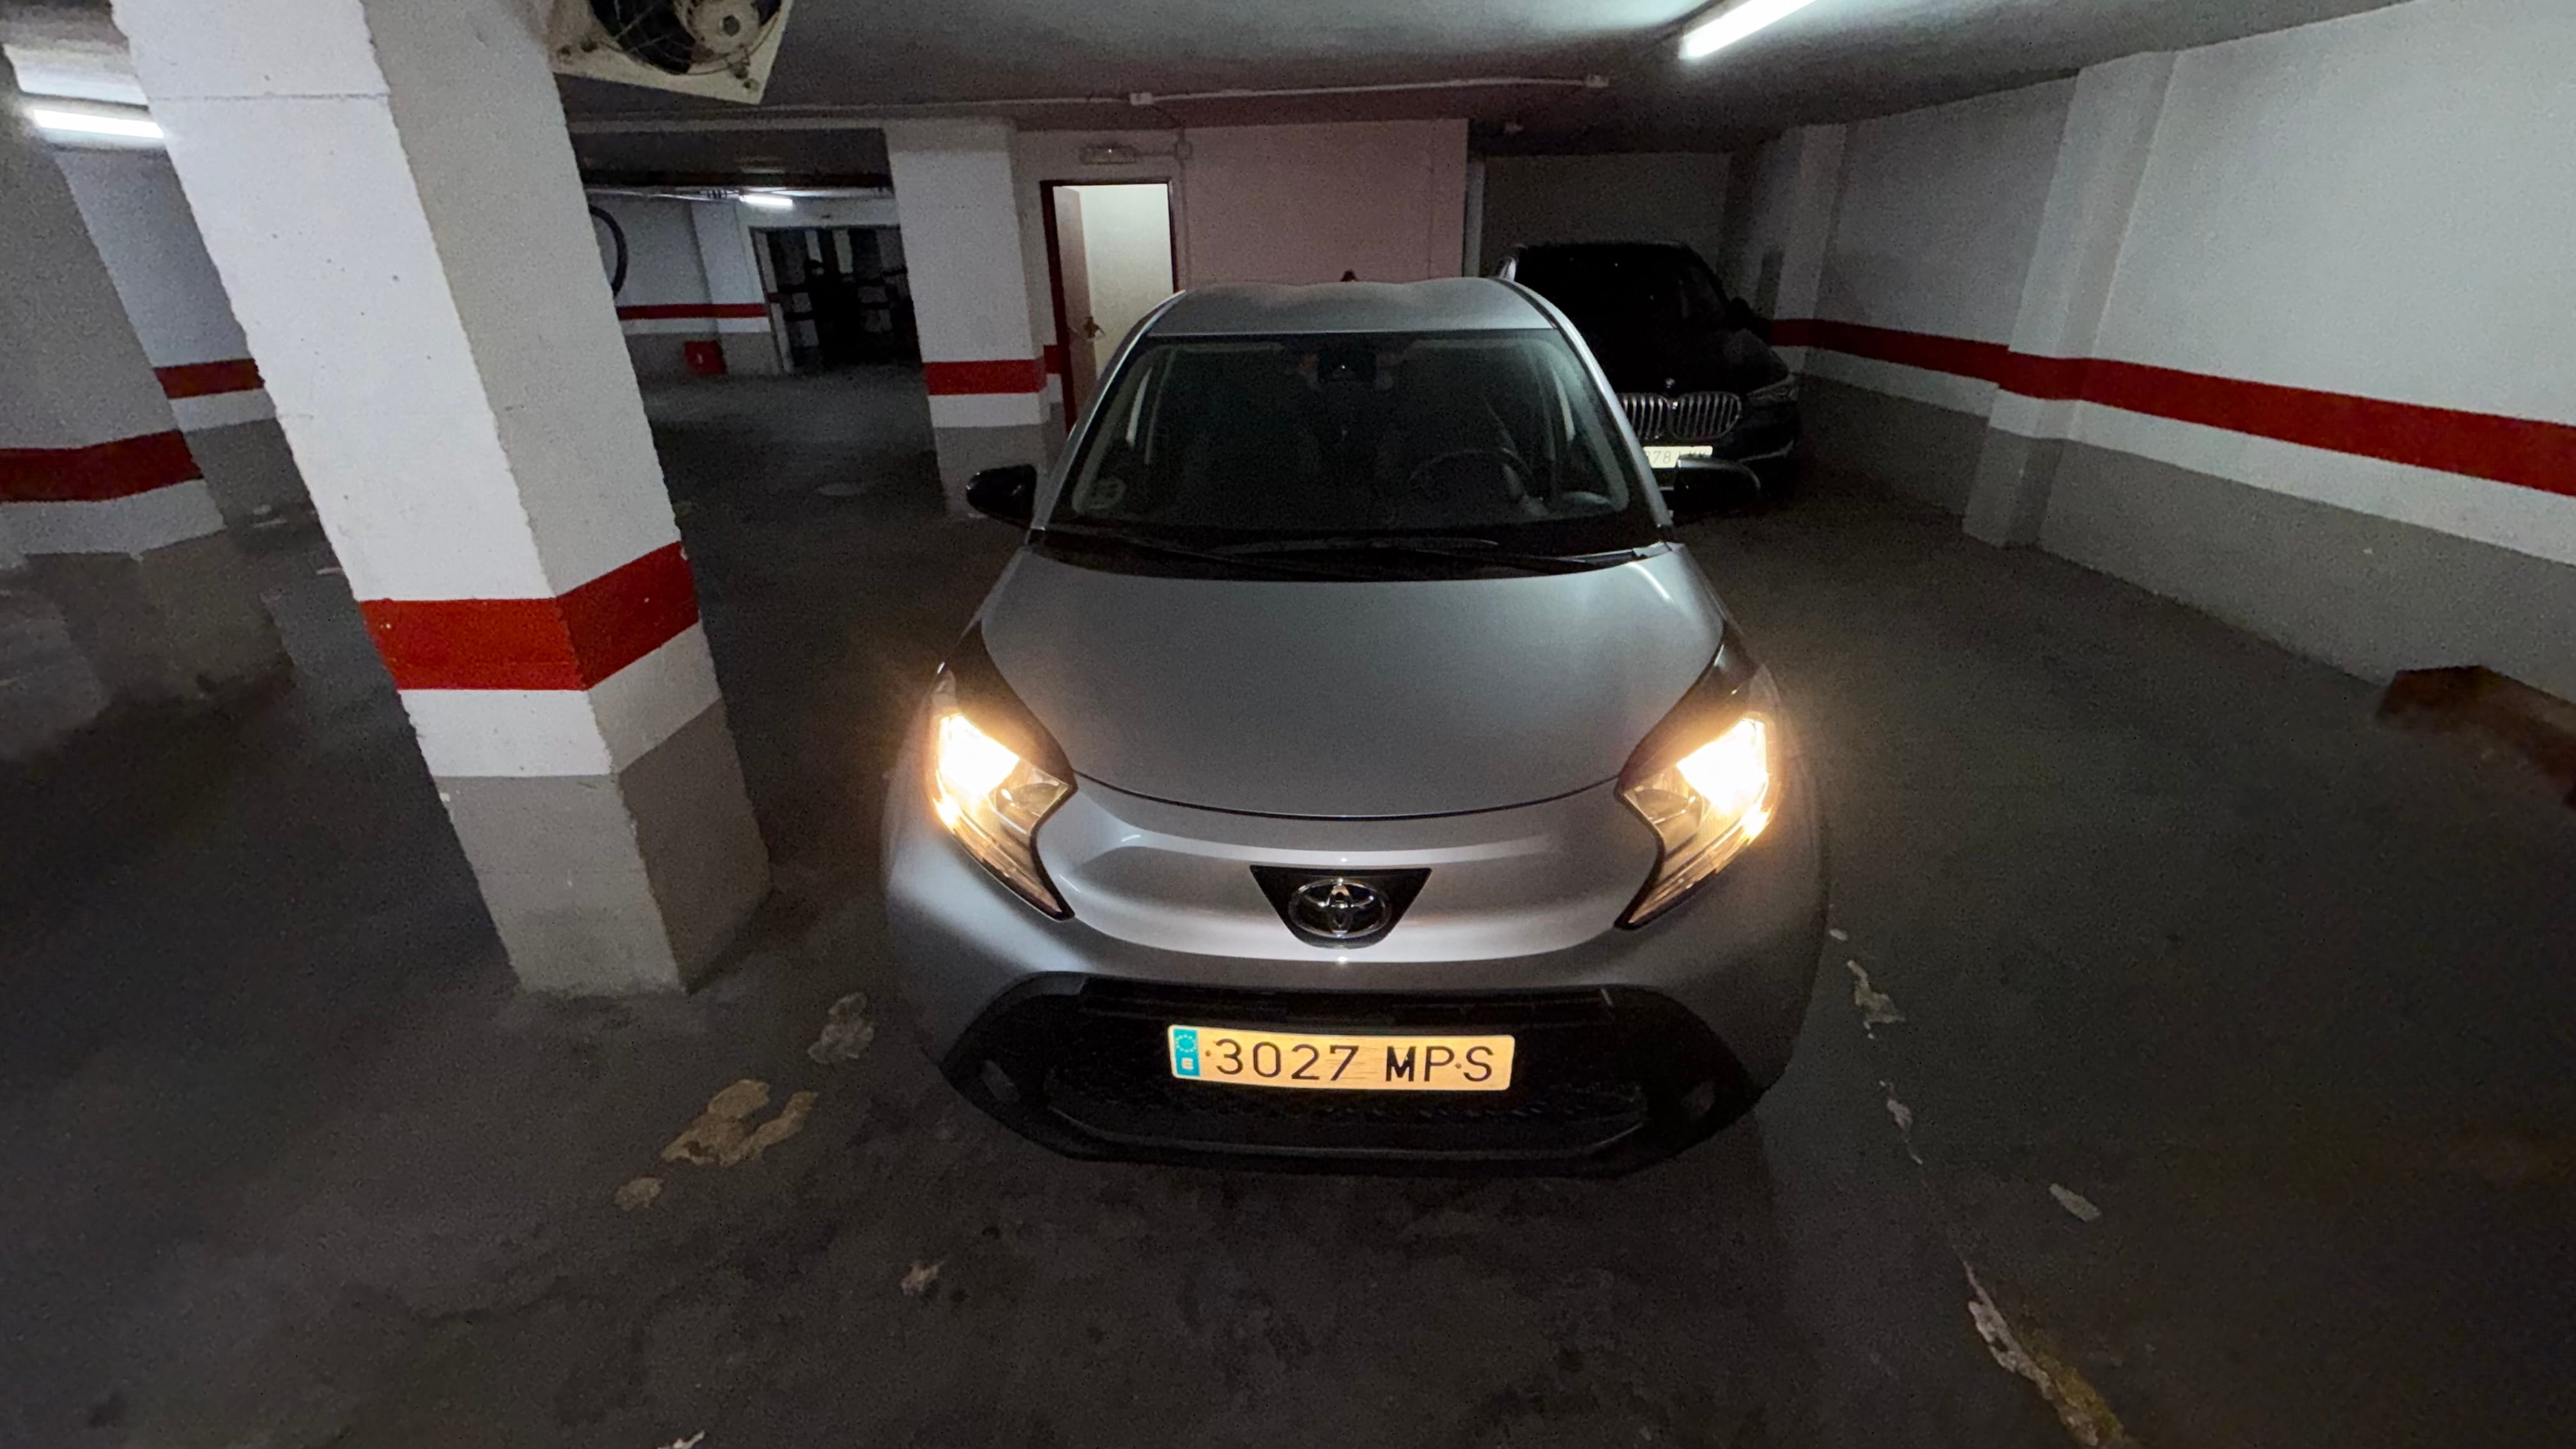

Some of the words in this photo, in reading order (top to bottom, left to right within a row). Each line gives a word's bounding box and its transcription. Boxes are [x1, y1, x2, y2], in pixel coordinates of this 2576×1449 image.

[1646, 450, 1672, 464] 78
[1181, 1057, 1193, 1070] E
[1215, 1038, 1359, 1082] 3027
[1385, 1045, 1494, 1082] MPS
